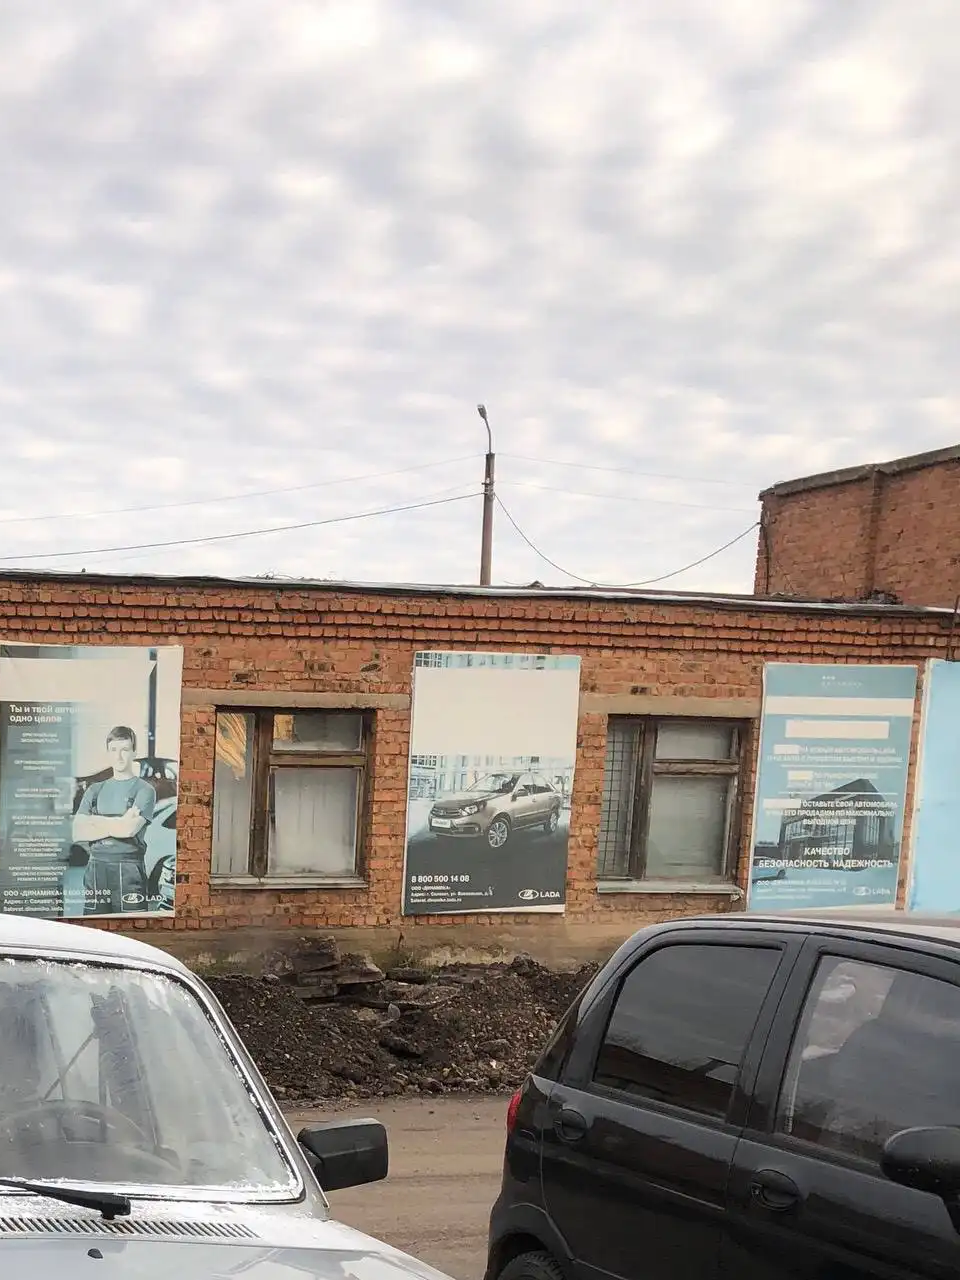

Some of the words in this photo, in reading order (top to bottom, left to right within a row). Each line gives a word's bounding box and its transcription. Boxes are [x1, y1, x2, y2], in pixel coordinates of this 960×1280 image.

[9, 704, 22, 713] Ты
[24, 705, 30, 713] и
[31, 705, 53, 714] твой
[10, 715, 33, 723] одно
[34, 715, 62, 723] целое
[804, 847, 851, 856] КАЧЕСТВО
[759, 860, 829, 868] БЕЗОПАСНОСТЬ
[833, 860, 893, 869] НАДЕЖНОСТЬ
[411, 875, 417, 883] 8
[418, 875, 433, 883] 800
